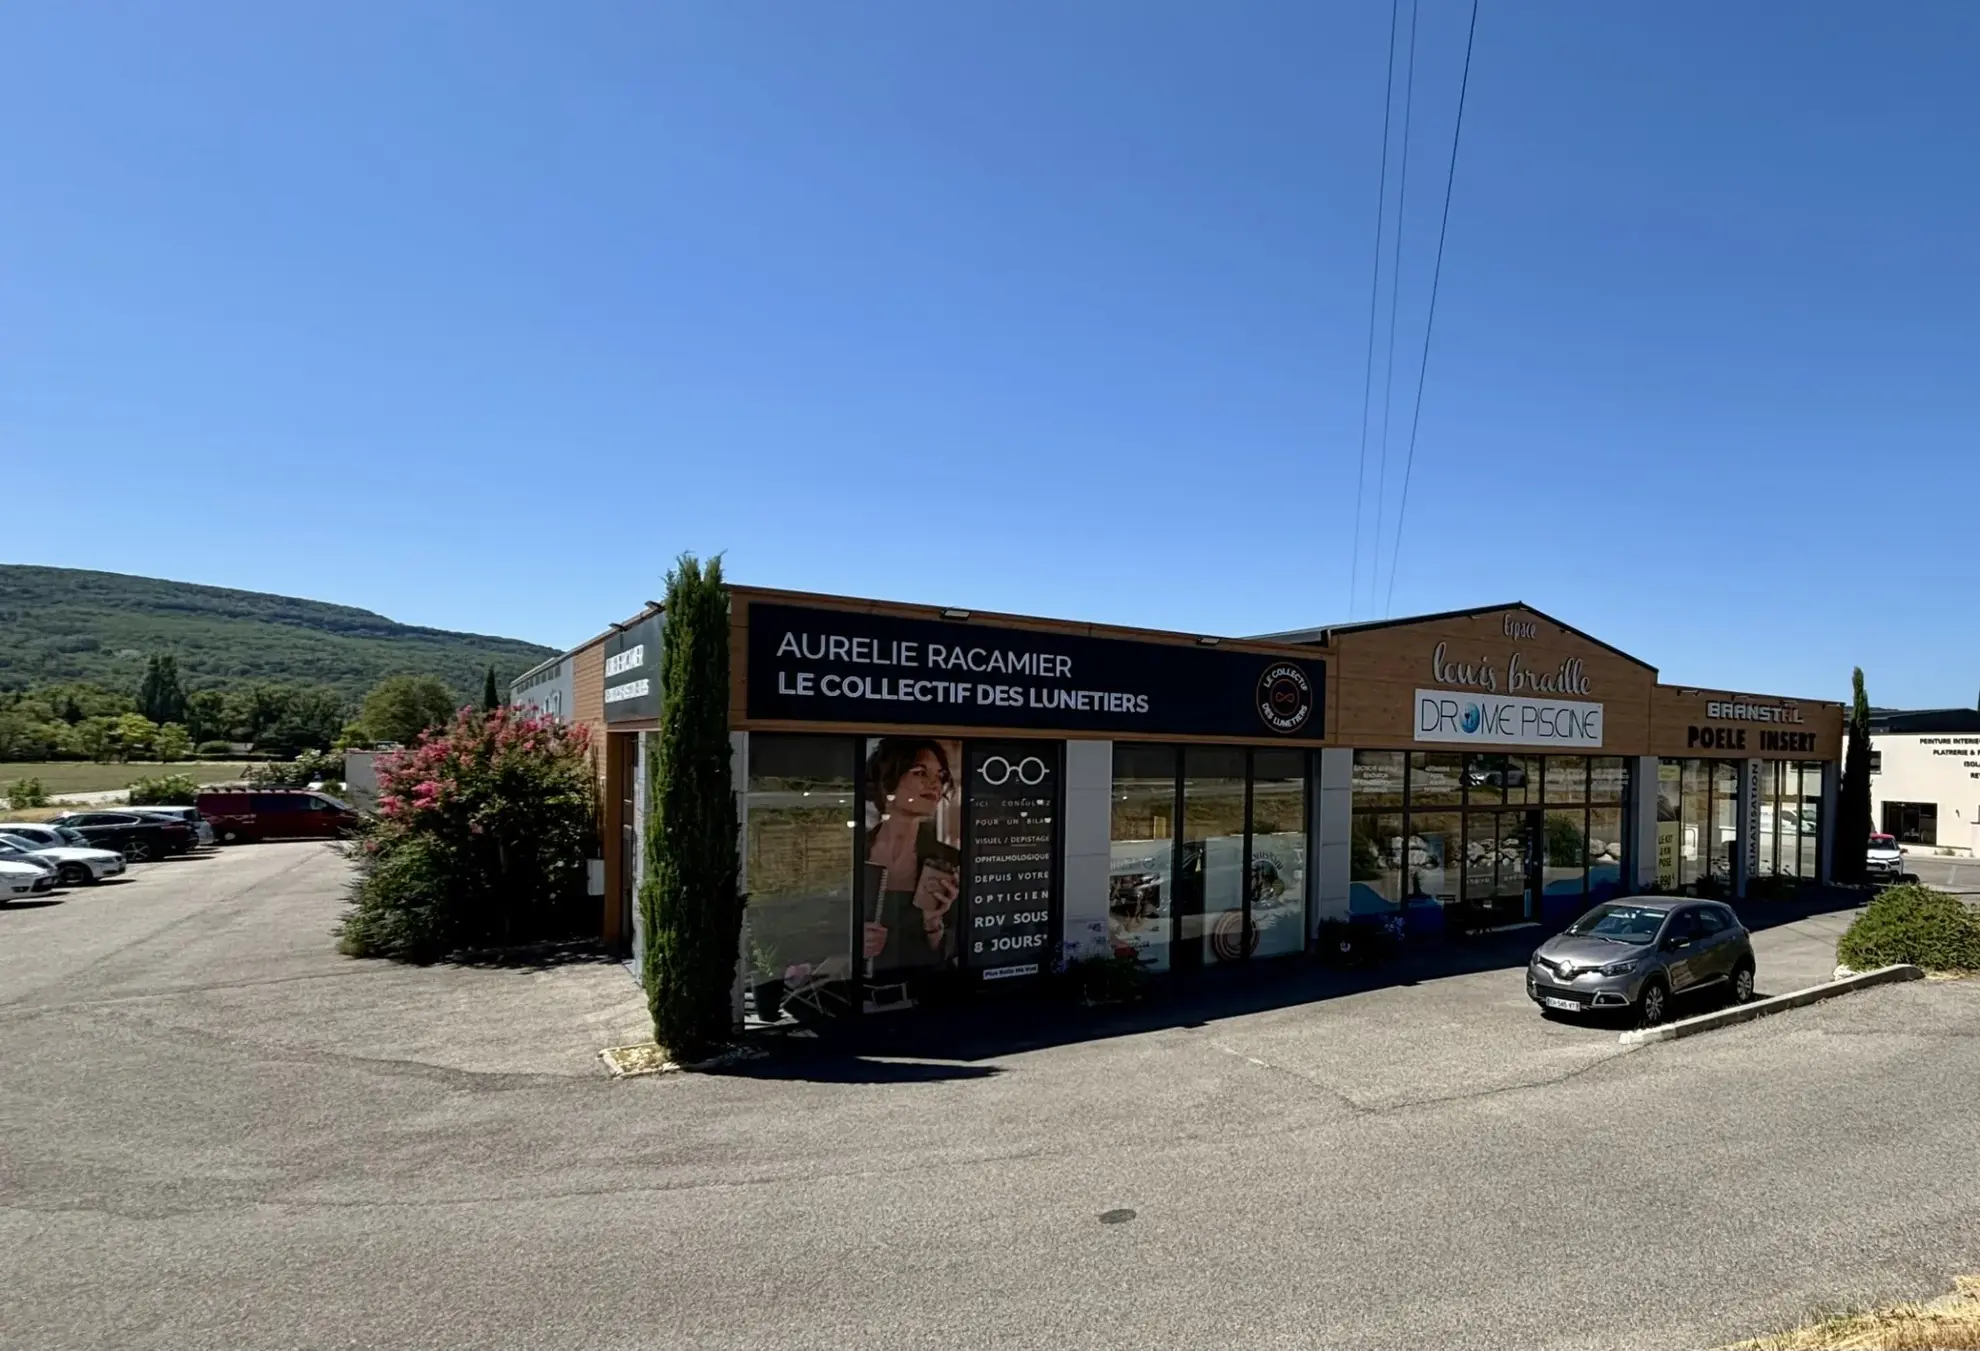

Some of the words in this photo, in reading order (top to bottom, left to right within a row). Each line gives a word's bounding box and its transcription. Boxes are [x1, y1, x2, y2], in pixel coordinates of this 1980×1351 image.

[776, 631, 919, 667] AURELIE
[928, 643, 1072, 678] RACAMIER
[1263, 675, 1274, 688] LE
[1271, 667, 1308, 691] COLLECTIF
[1508, 652, 1592, 696] braille
[779, 671, 815, 696] LE
[820, 674, 972, 704] COLLECTIF
[976, 684, 1025, 707] DES
[1029, 687, 1149, 713] LUNETIERS
[1262, 702, 1274, 719] DES
[1273, 704, 1308, 728] LUNETIERS
[1687, 725, 1746, 751] POELE
[1760, 730, 1816, 752] INSERT
[975, 819, 999, 827] POUR
[1026, 817, 1051, 825] BILA
[1747, 763, 1759, 876] CLIMATISATION
[974, 836, 1002, 845] VISUEL
[1010, 834, 1050, 844] DEPISTAGE
[975, 853, 1050, 864] OPHTALMOLOGIQUE
[975, 873, 1012, 883] DEPUIS
[1018, 871, 1049, 880] VOTRE
[974, 890, 1049, 904] OPTICIEN
[974, 914, 1005, 928] RDV
[1013, 910, 1049, 924] SOUS
[974, 942, 984, 953] 8
